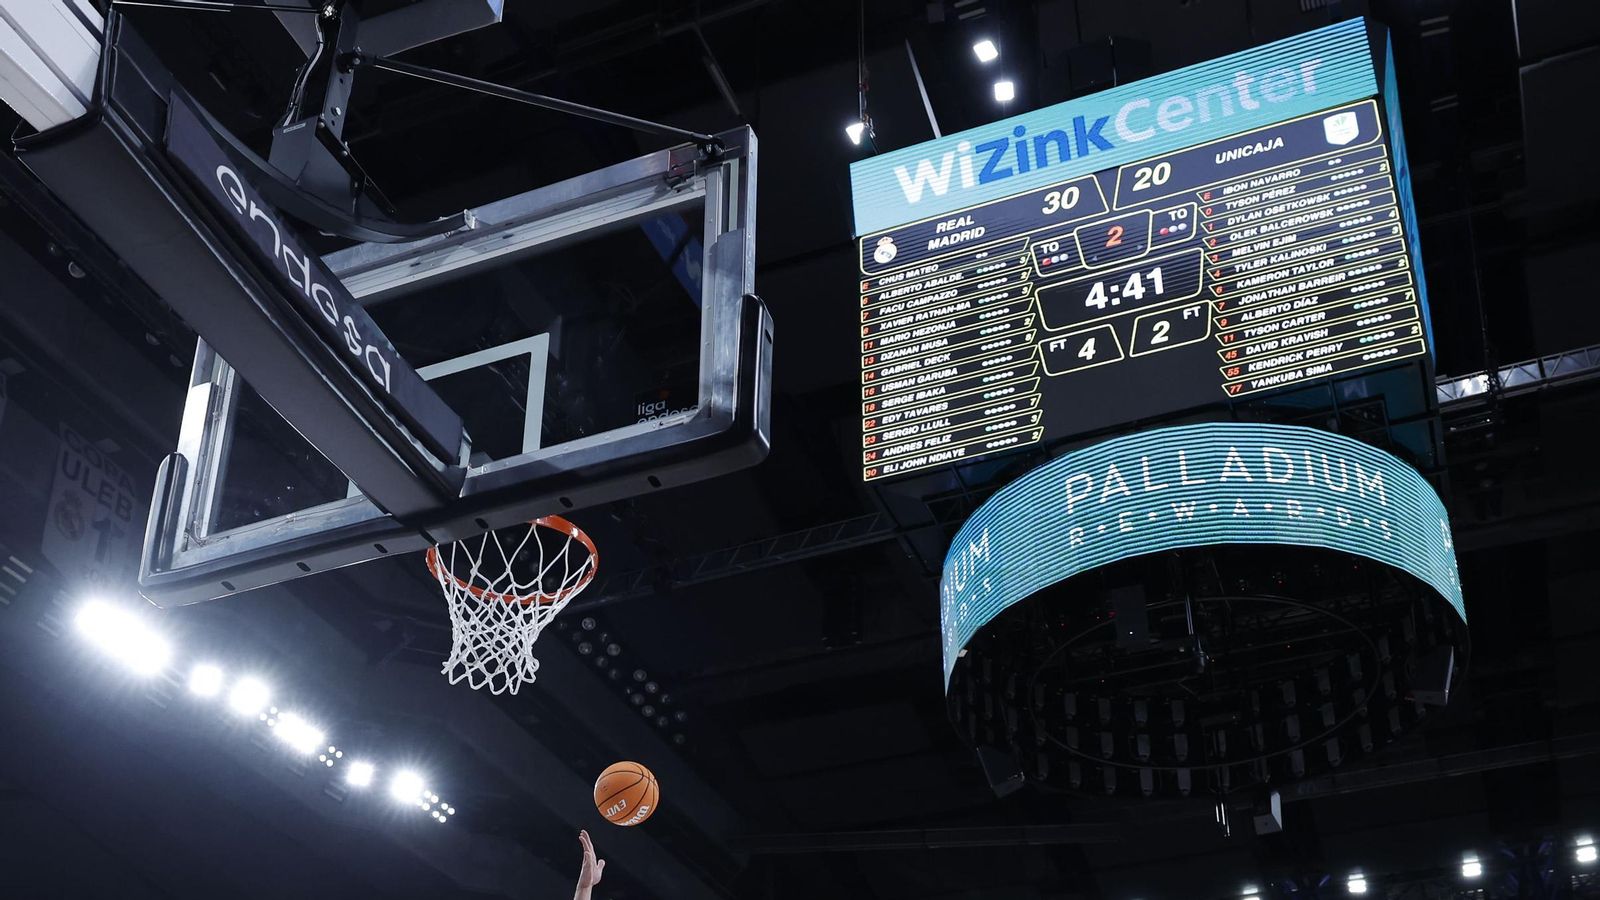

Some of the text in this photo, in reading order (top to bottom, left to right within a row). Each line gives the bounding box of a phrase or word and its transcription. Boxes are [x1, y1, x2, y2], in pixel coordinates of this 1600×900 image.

[1215, 136, 1285, 165] UNICAJA
[1132, 162, 1172, 192] 20
[1223, 180, 1248, 195] IBON
[1250, 168, 1301, 188] NAVARRO
[1225, 195, 1260, 210] TYSON
[1262, 185, 1296, 201] PÉREZ
[1379, 163, 1387, 172] 2
[1042, 186, 1080, 215] 30
[1168, 208, 1188, 221] TO
[1227, 210, 1263, 226] DYLAN
[1264, 193, 1331, 216] OSETKOWSK
[928, 226, 986, 250] MADRID
[936, 215, 975, 234] REAL
[1105, 225, 1124, 248] 2
[1210, 208, 1334, 247] 2 OLEK BALCEROWSK
[1232, 240, 1270, 257] MELVIN
[1272, 234, 1297, 247] EJIM
[1389, 210, 1395, 218] 4
[1040, 241, 1060, 254] TO
[1234, 257, 1268, 272] TYLER
[1270, 243, 1327, 263] KALINOSKI
[216, 165, 391, 394] endesa
[879, 273, 904, 286] CHUS
[906, 263, 939, 276] MATEO
[1085, 267, 1164, 309] 4:41
[1218, 259, 1405, 310] 7 JONATHAN BARREIR 2
[1236, 269, 1290, 289] KAMERON
[1291, 258, 1335, 276] TAYLOR
[879, 284, 922, 301] ALBERTO
[879, 302, 905, 316] FACU
[906, 289, 958, 308] CAMPAZZO
[1020, 271, 1027, 279] 2
[880, 316, 914, 330] XAVIER
[915, 301, 971, 321] RATHAN-MA
[1021, 286, 1028, 294] 3
[1182, 305, 1201, 320] FT
[1223, 291, 1412, 343] 11 TYSON CARTER 7
[1241, 302, 1291, 321] ALBERTO
[1293, 296, 1318, 308] DÍAZ
[864, 320, 956, 350] 11 MARIO HEZONJA
[864, 317, 1031, 365] 13 DZANAN MUSA 2
[1050, 339, 1067, 352] FT
[1150, 320, 1170, 345] 2
[1225, 328, 1329, 360] 45 DAVID KRAVISH
[1077, 337, 1096, 360] 4
[1227, 325, 1418, 376] 55 KENDRICK PERRY 2
[865, 372, 874, 380] 14
[881, 360, 922, 376] GABRIEL
[924, 353, 951, 366] DECK
[881, 377, 915, 392] USMAN
[917, 367, 958, 383] GARUBA
[1230, 363, 1333, 394] 77 YANKUBA SIMA
[637, 400, 666, 416] liga
[881, 394, 914, 408] SERGE
[916, 386, 946, 400] IBAKA
[865, 402, 948, 428] 22 EDY TAVARES
[865, 398, 1037, 444] 23 SERGIO LLULL 7
[865, 452, 876, 460] 24
[882, 441, 923, 457] ANDRES
[924, 434, 952, 447] FELIZ
[865, 431, 1039, 477] 30 ELI JOHN NDIAYE 2
[62, 450, 133, 522] ULEB
[1065, 446, 1387, 515] PALLADIUM
